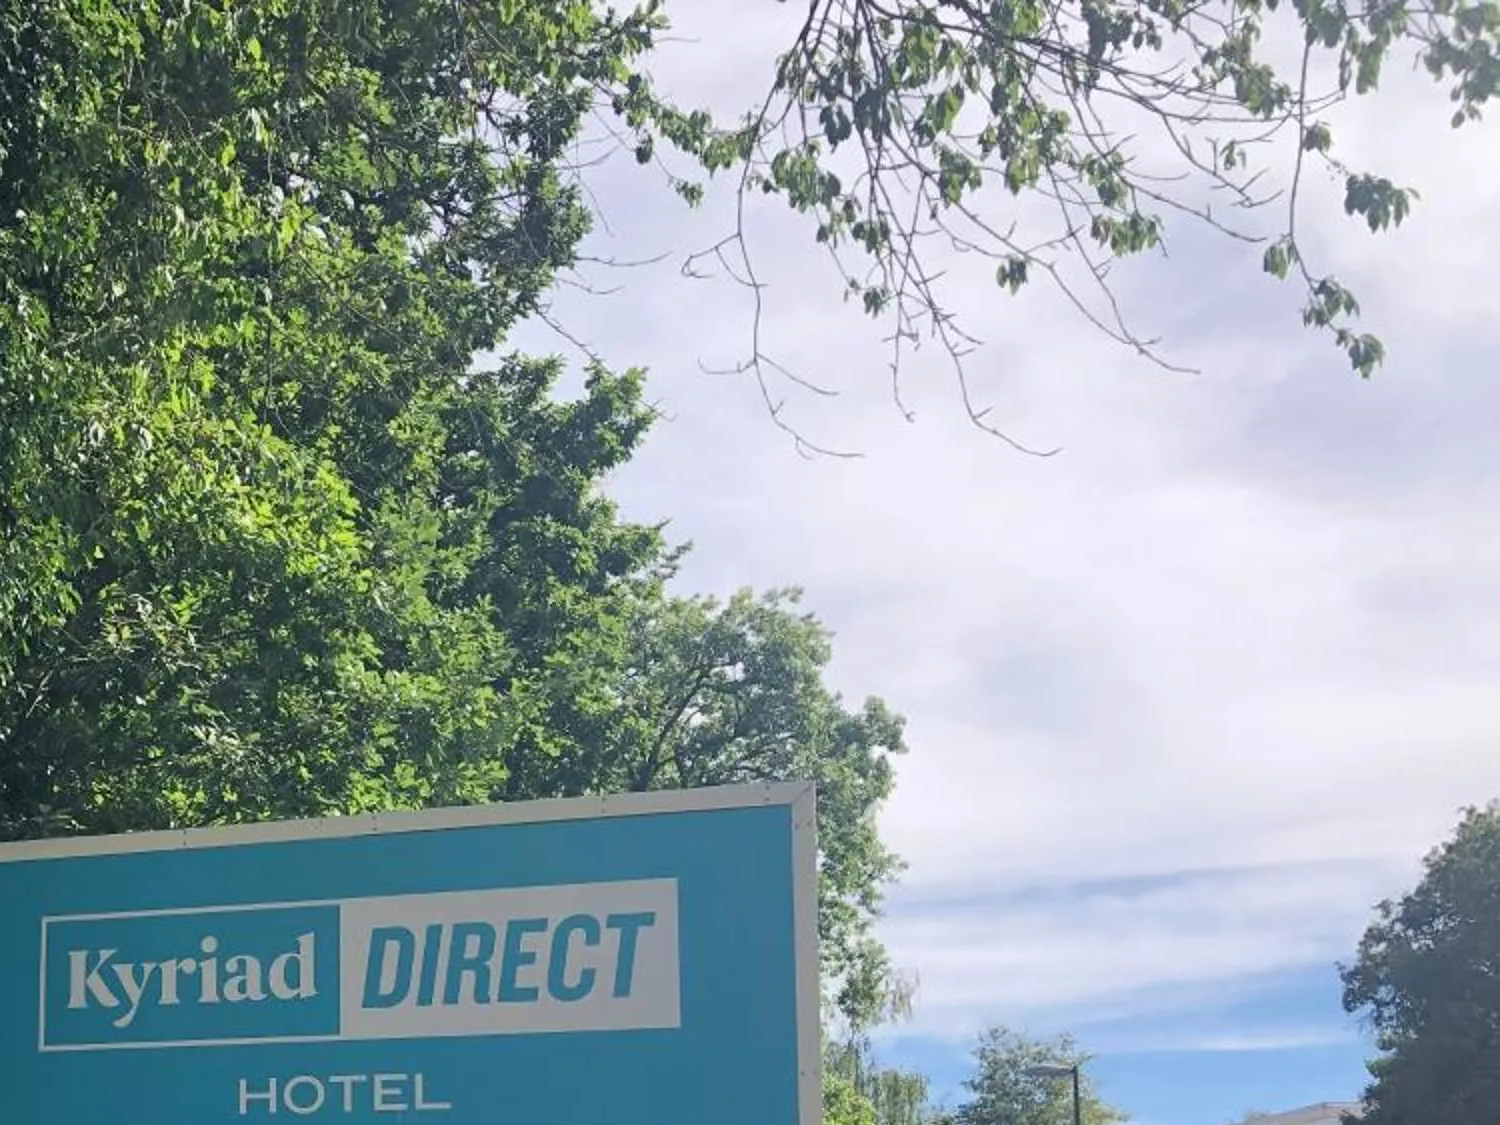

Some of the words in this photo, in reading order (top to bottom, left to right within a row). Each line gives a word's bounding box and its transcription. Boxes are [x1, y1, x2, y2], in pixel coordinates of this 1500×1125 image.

[67, 932, 318, 1028] Kyriad
[362, 912, 656, 1009] DIRECT
[239, 1073, 451, 1115] HOTEL
